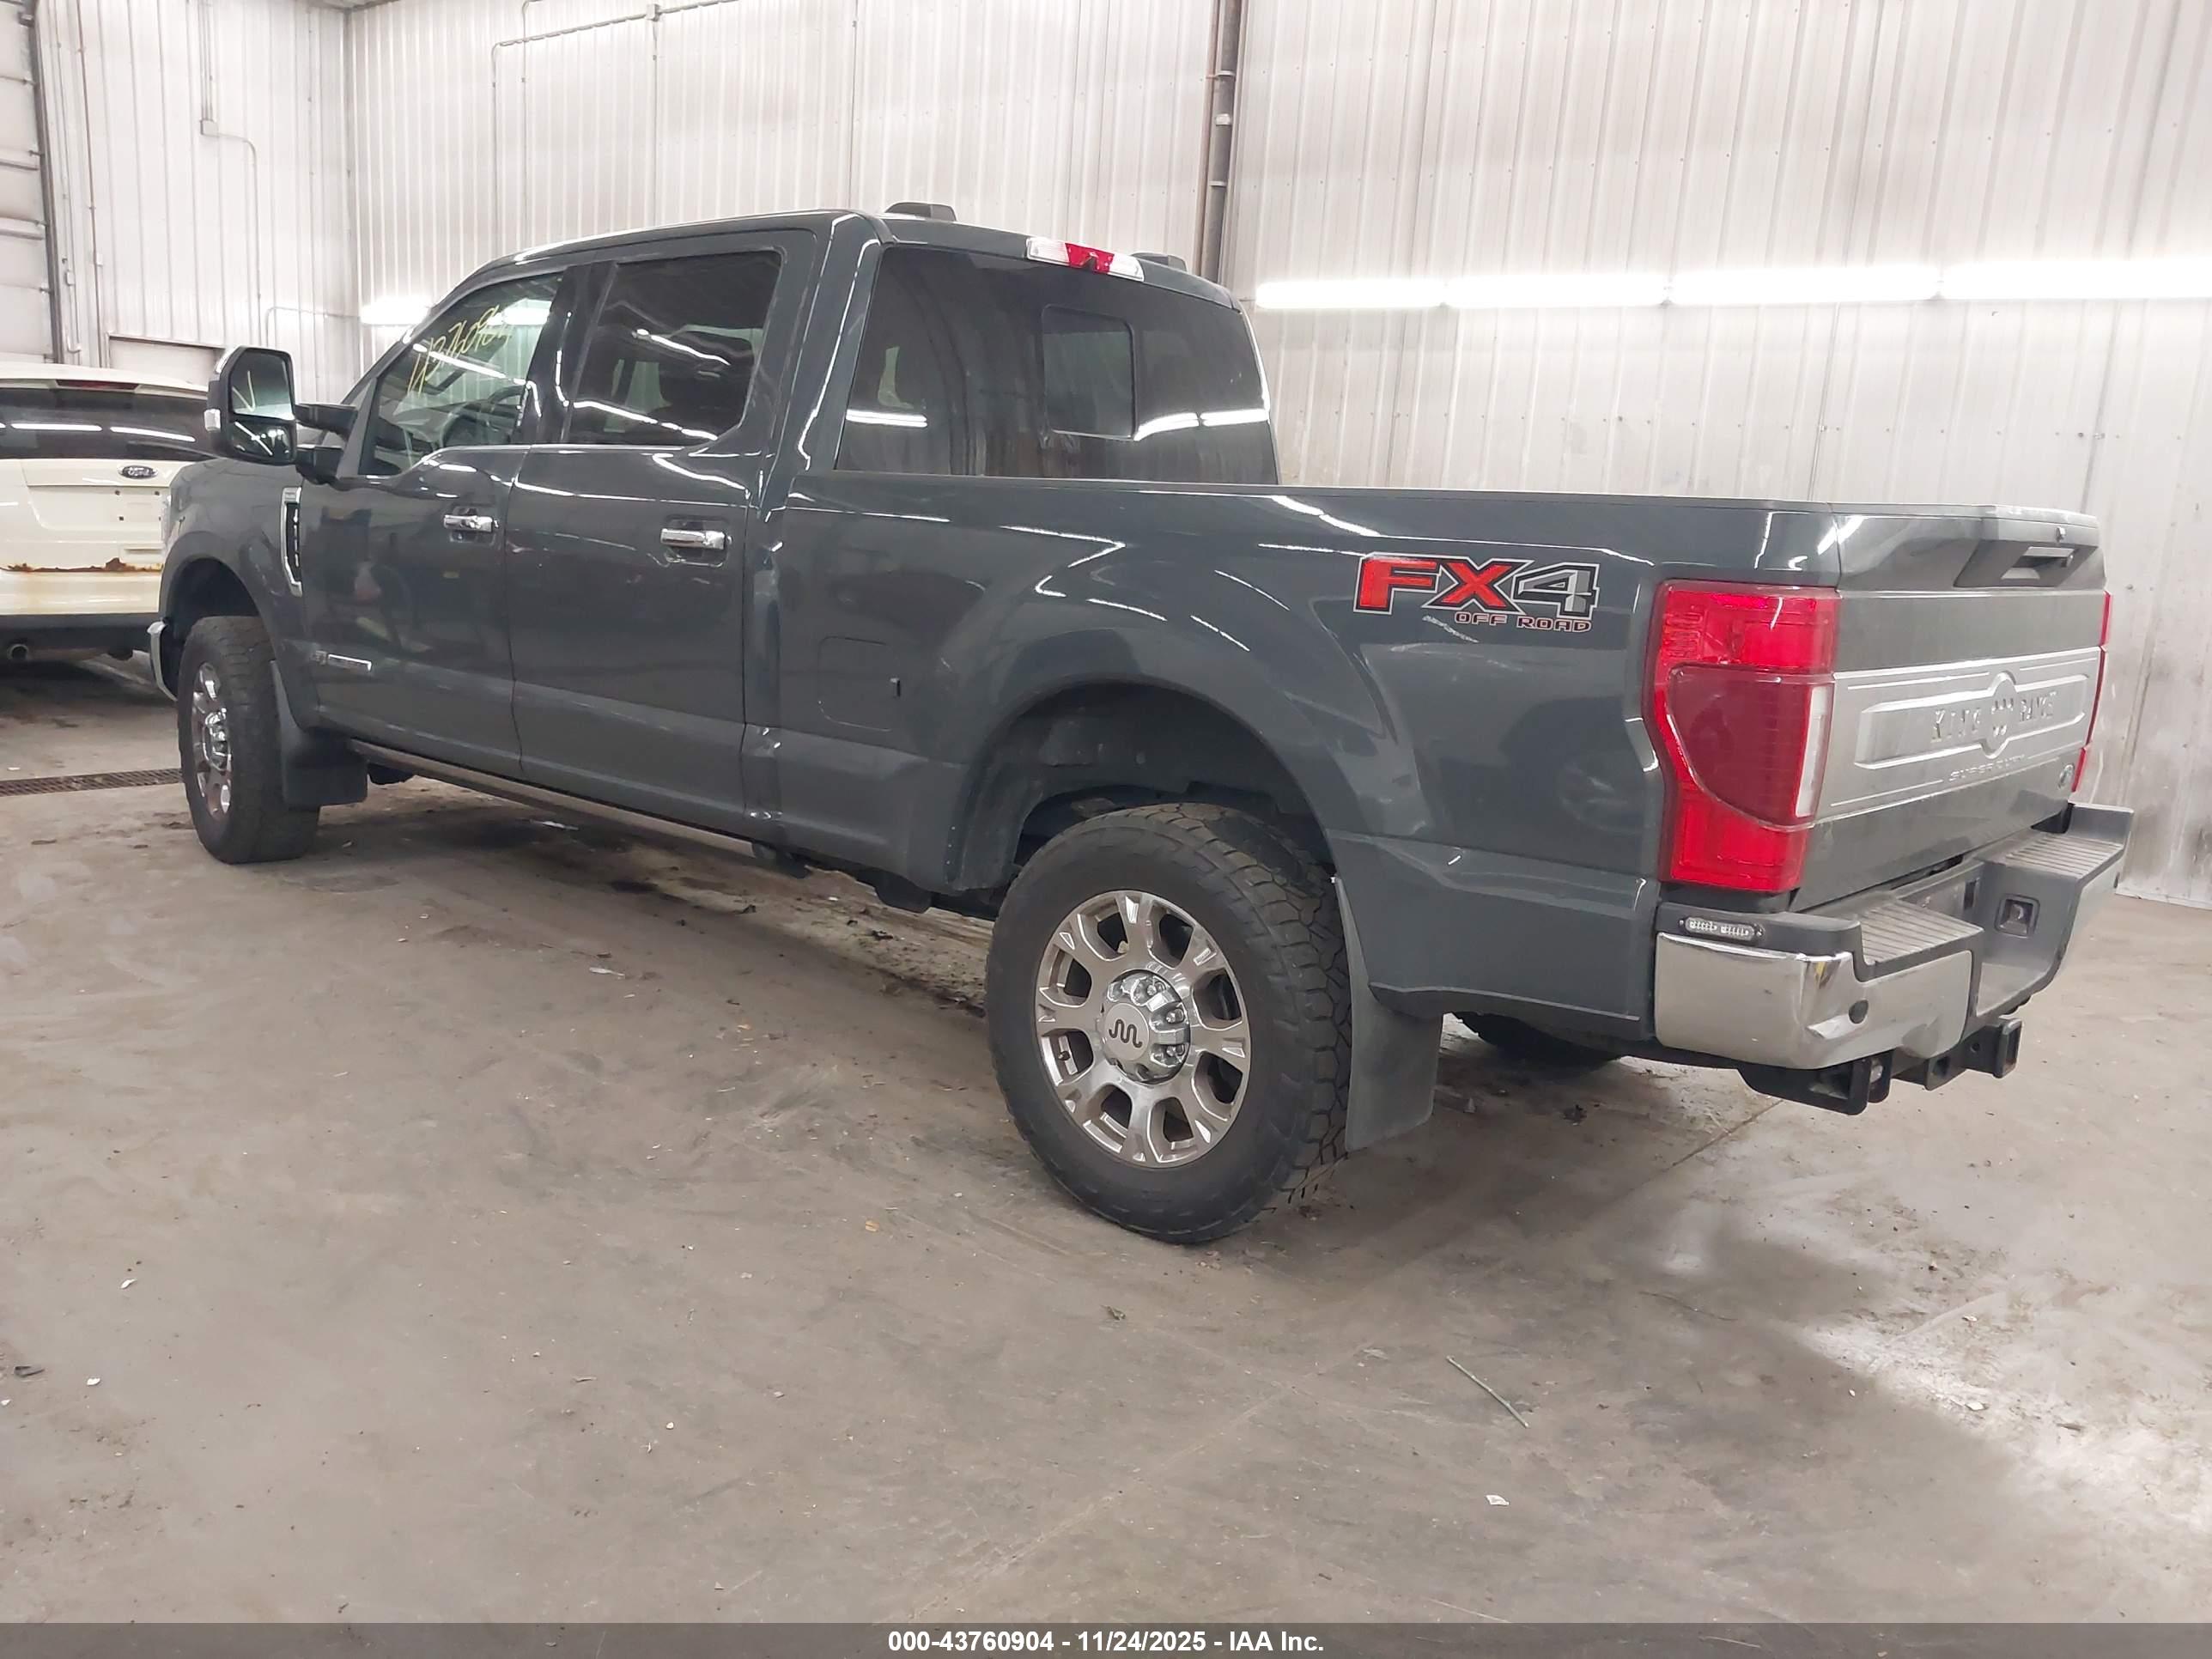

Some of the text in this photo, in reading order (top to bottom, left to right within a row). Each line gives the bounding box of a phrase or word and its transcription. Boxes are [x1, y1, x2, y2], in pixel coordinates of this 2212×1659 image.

[1353, 552, 1600, 620] FX4
[1455, 611, 1592, 633] OFF ROAD
